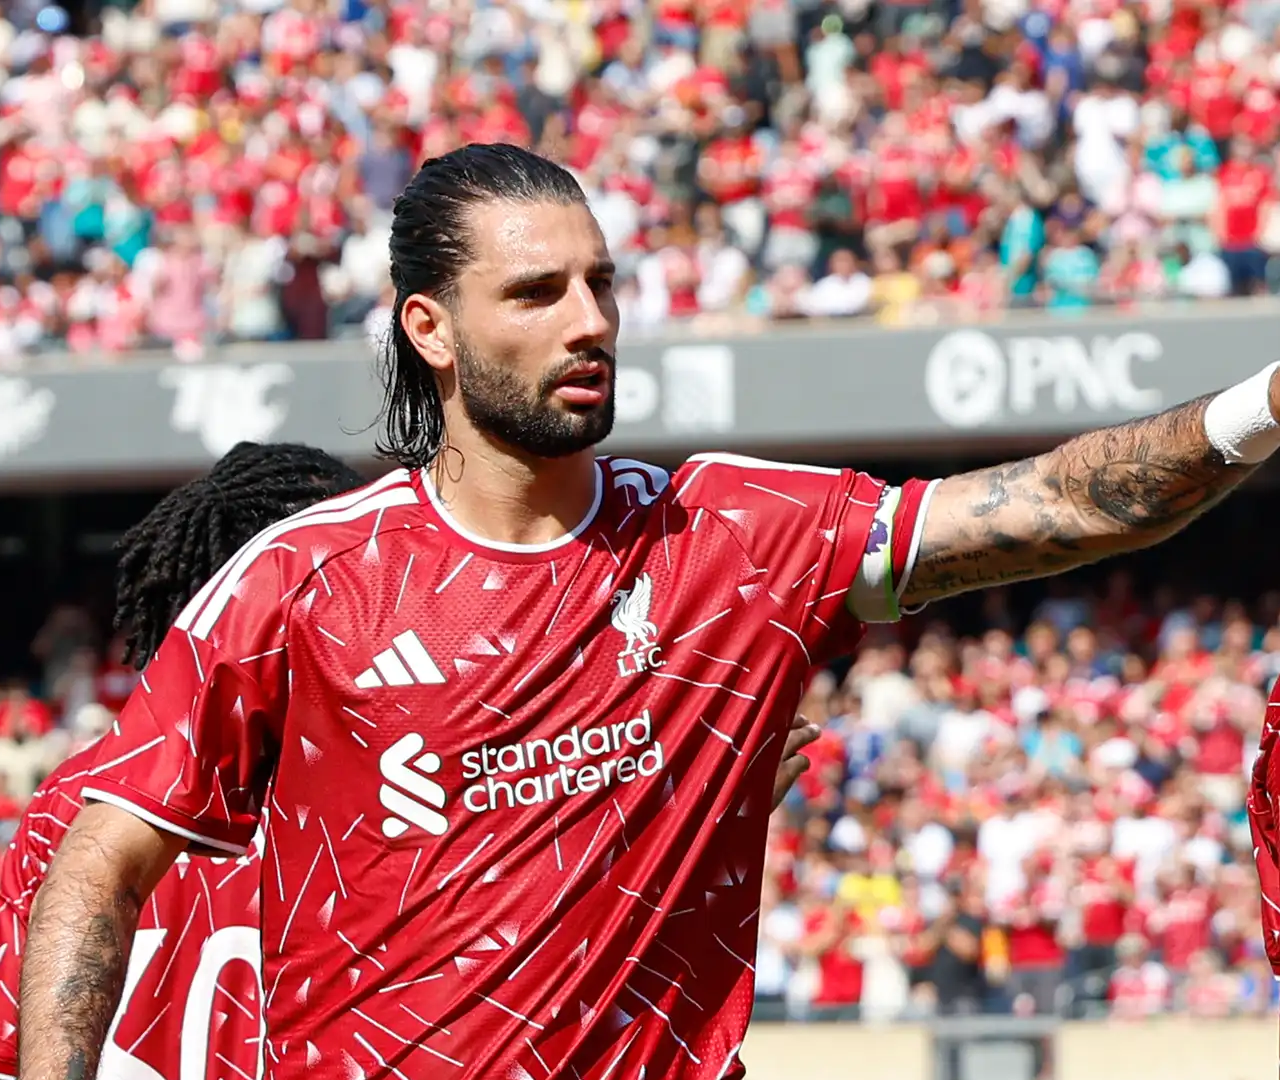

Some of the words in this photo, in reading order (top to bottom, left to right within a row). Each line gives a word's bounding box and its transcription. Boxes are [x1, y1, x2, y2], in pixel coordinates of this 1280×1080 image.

[1009, 332, 1162, 411] PNC
[461, 709, 652, 779] standard
[462, 741, 664, 814] chartered
